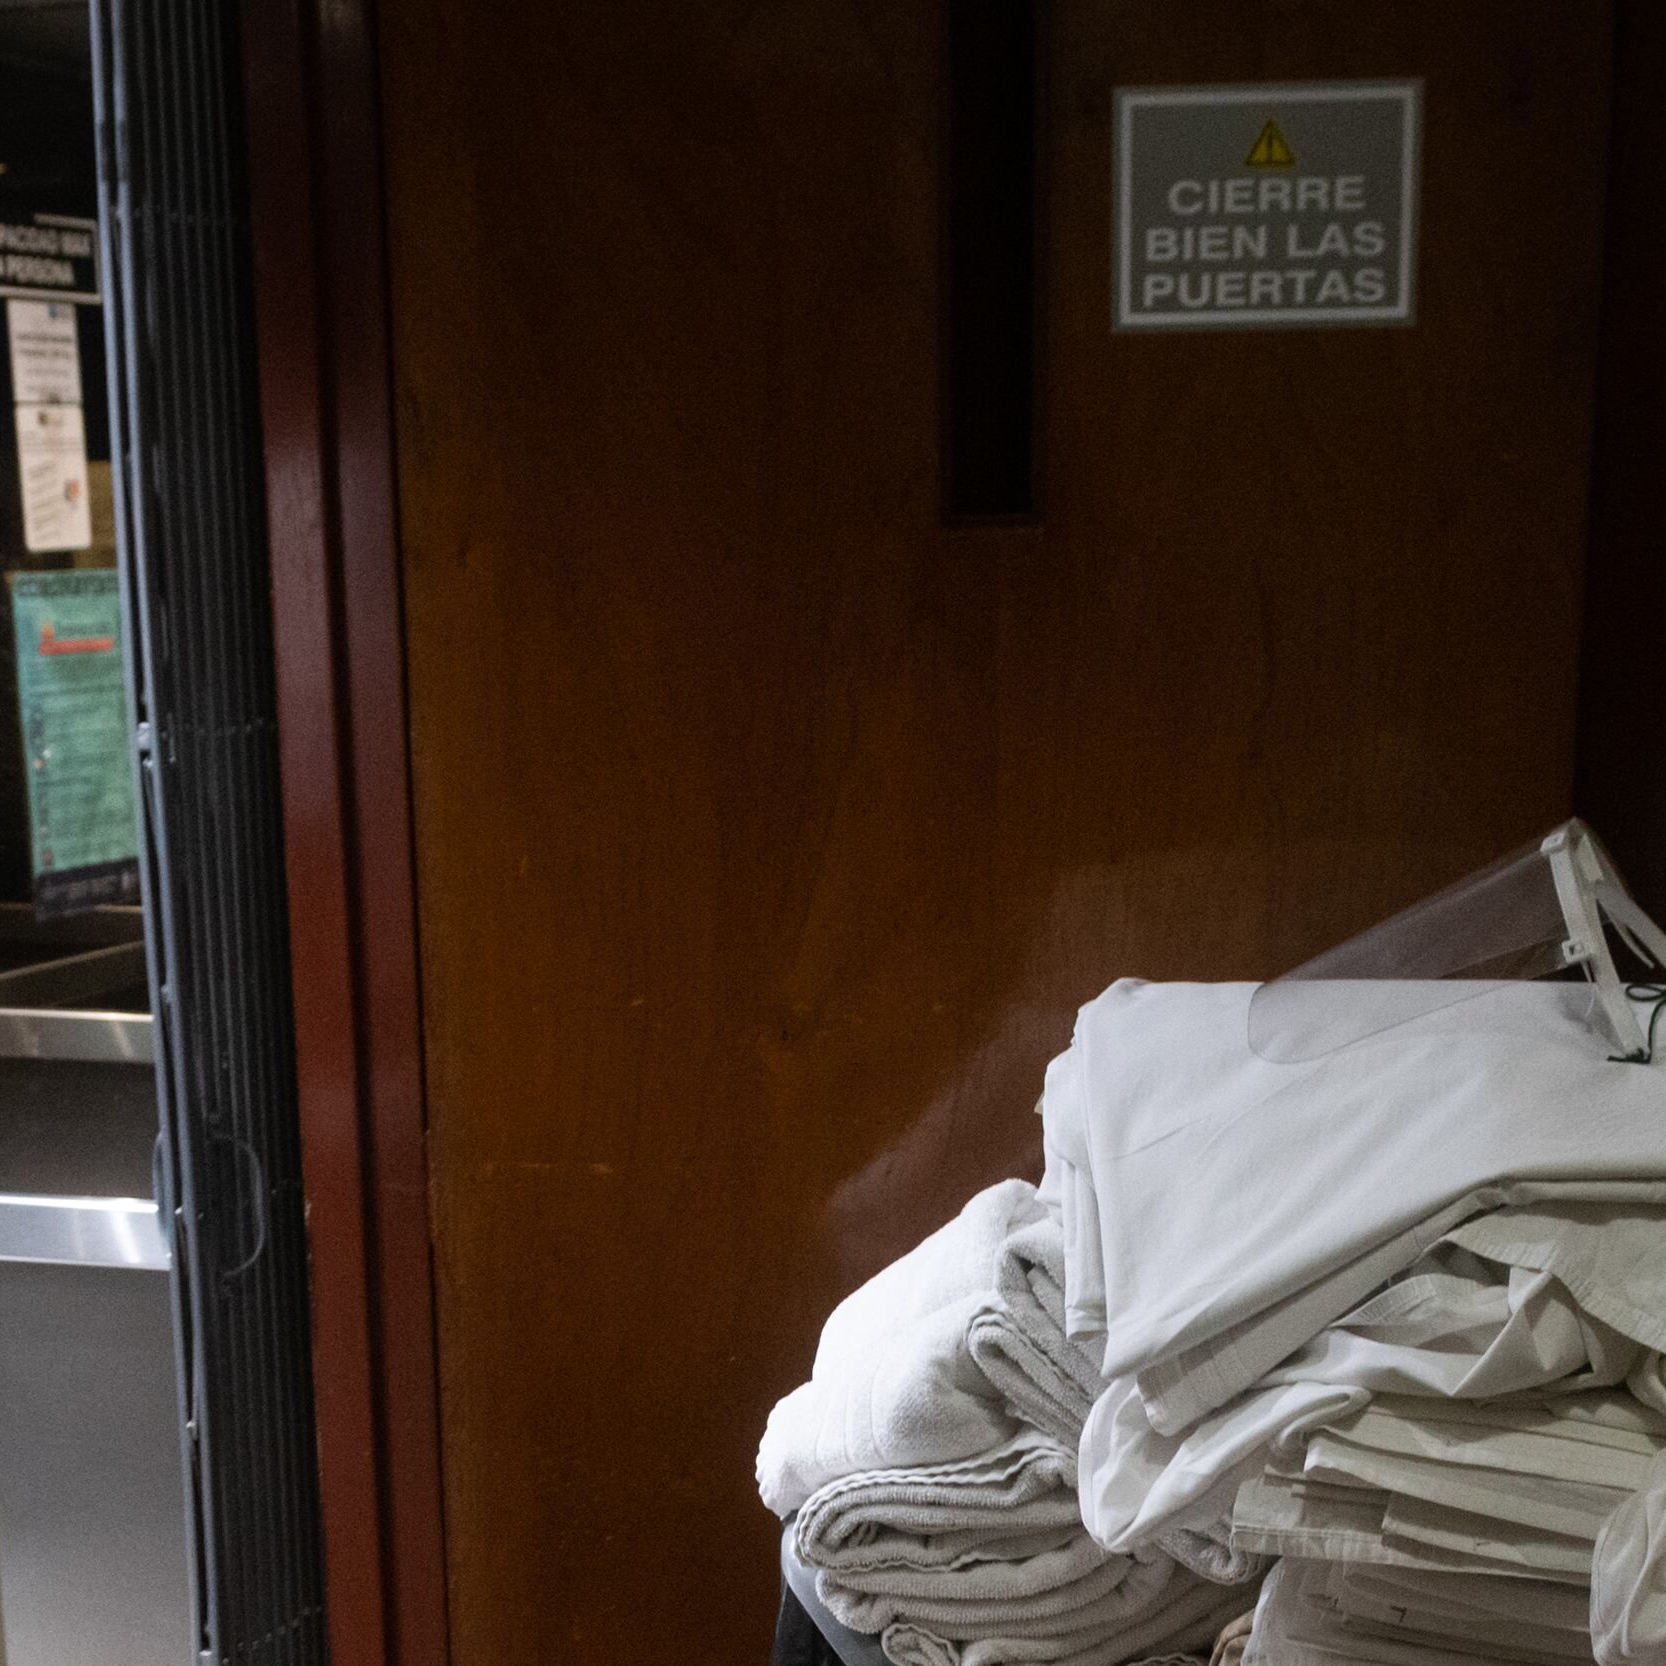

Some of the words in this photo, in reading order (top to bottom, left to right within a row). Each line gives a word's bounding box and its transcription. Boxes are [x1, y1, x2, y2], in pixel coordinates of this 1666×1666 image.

[1167, 175, 1367, 216] CIERRE
[1144, 224, 1268, 263] BIEN
[1286, 220, 1387, 258] LAS
[1142, 267, 1387, 309] PUERTAS
